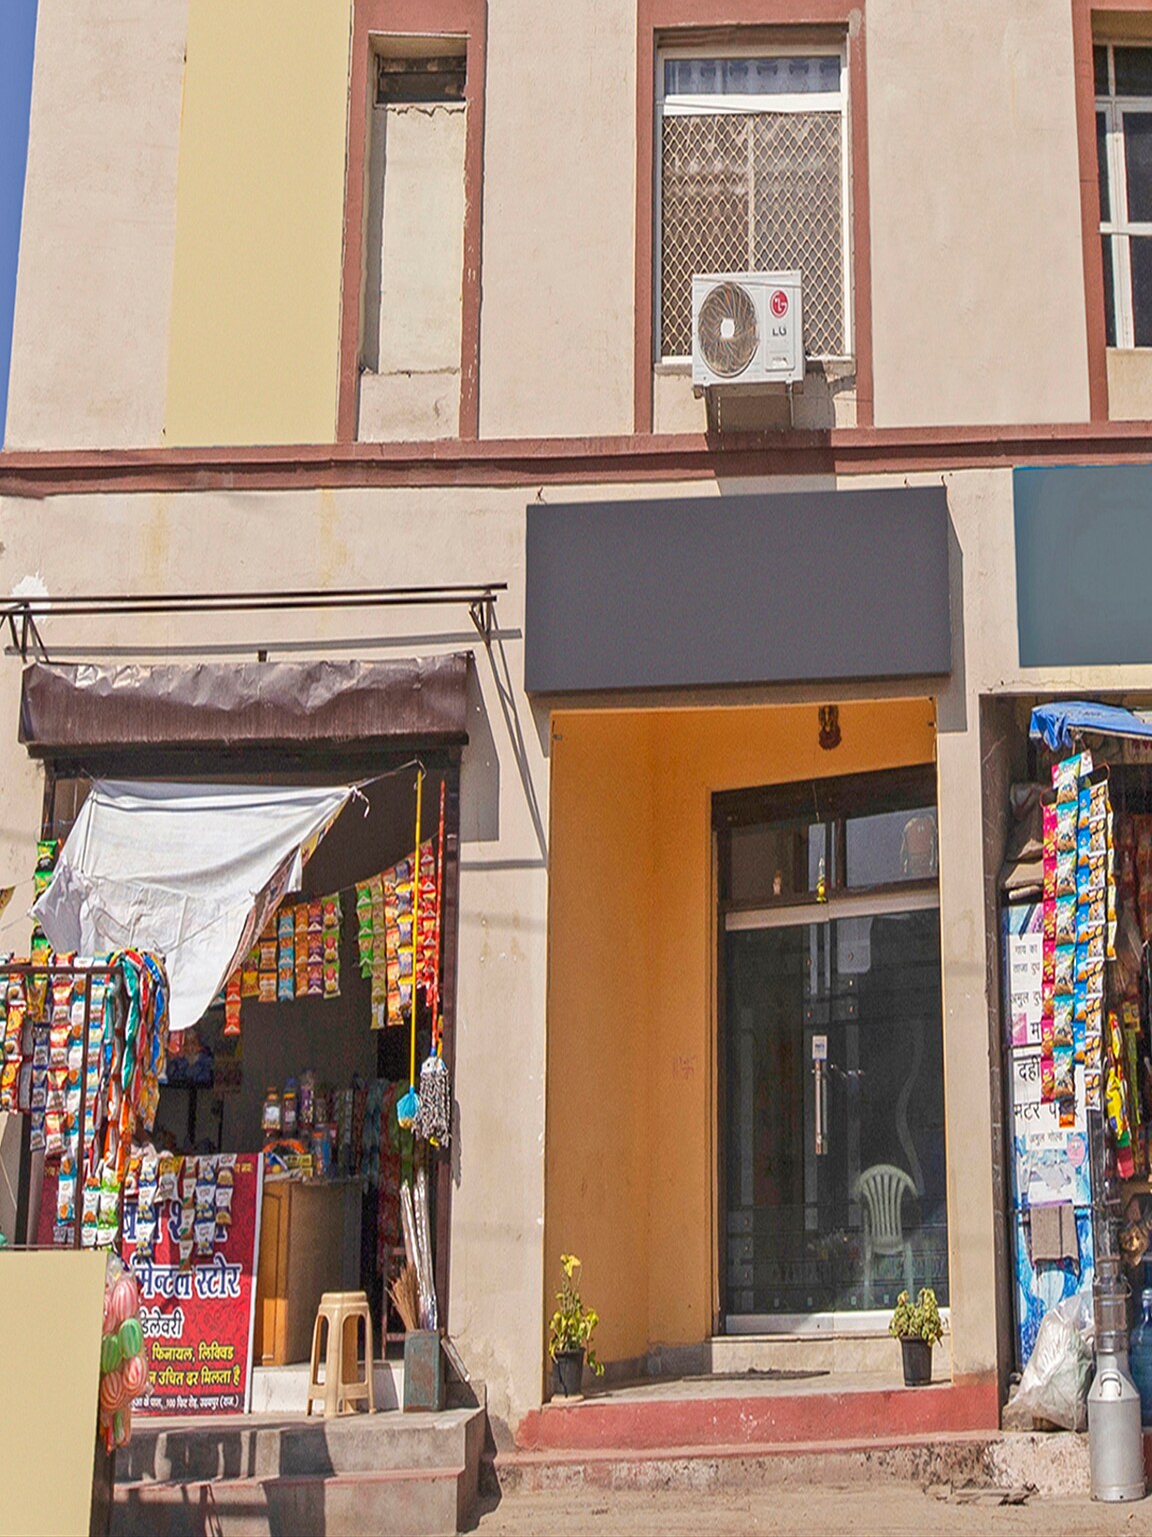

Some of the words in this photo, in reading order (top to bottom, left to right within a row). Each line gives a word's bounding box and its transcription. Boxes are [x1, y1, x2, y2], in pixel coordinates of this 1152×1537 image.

[772, 326, 787, 337] LG
[1017, 1055, 1040, 1082] दही
[195, 1253, 242, 1298] स्टोर
[158, 1365, 184, 1385] उचित
